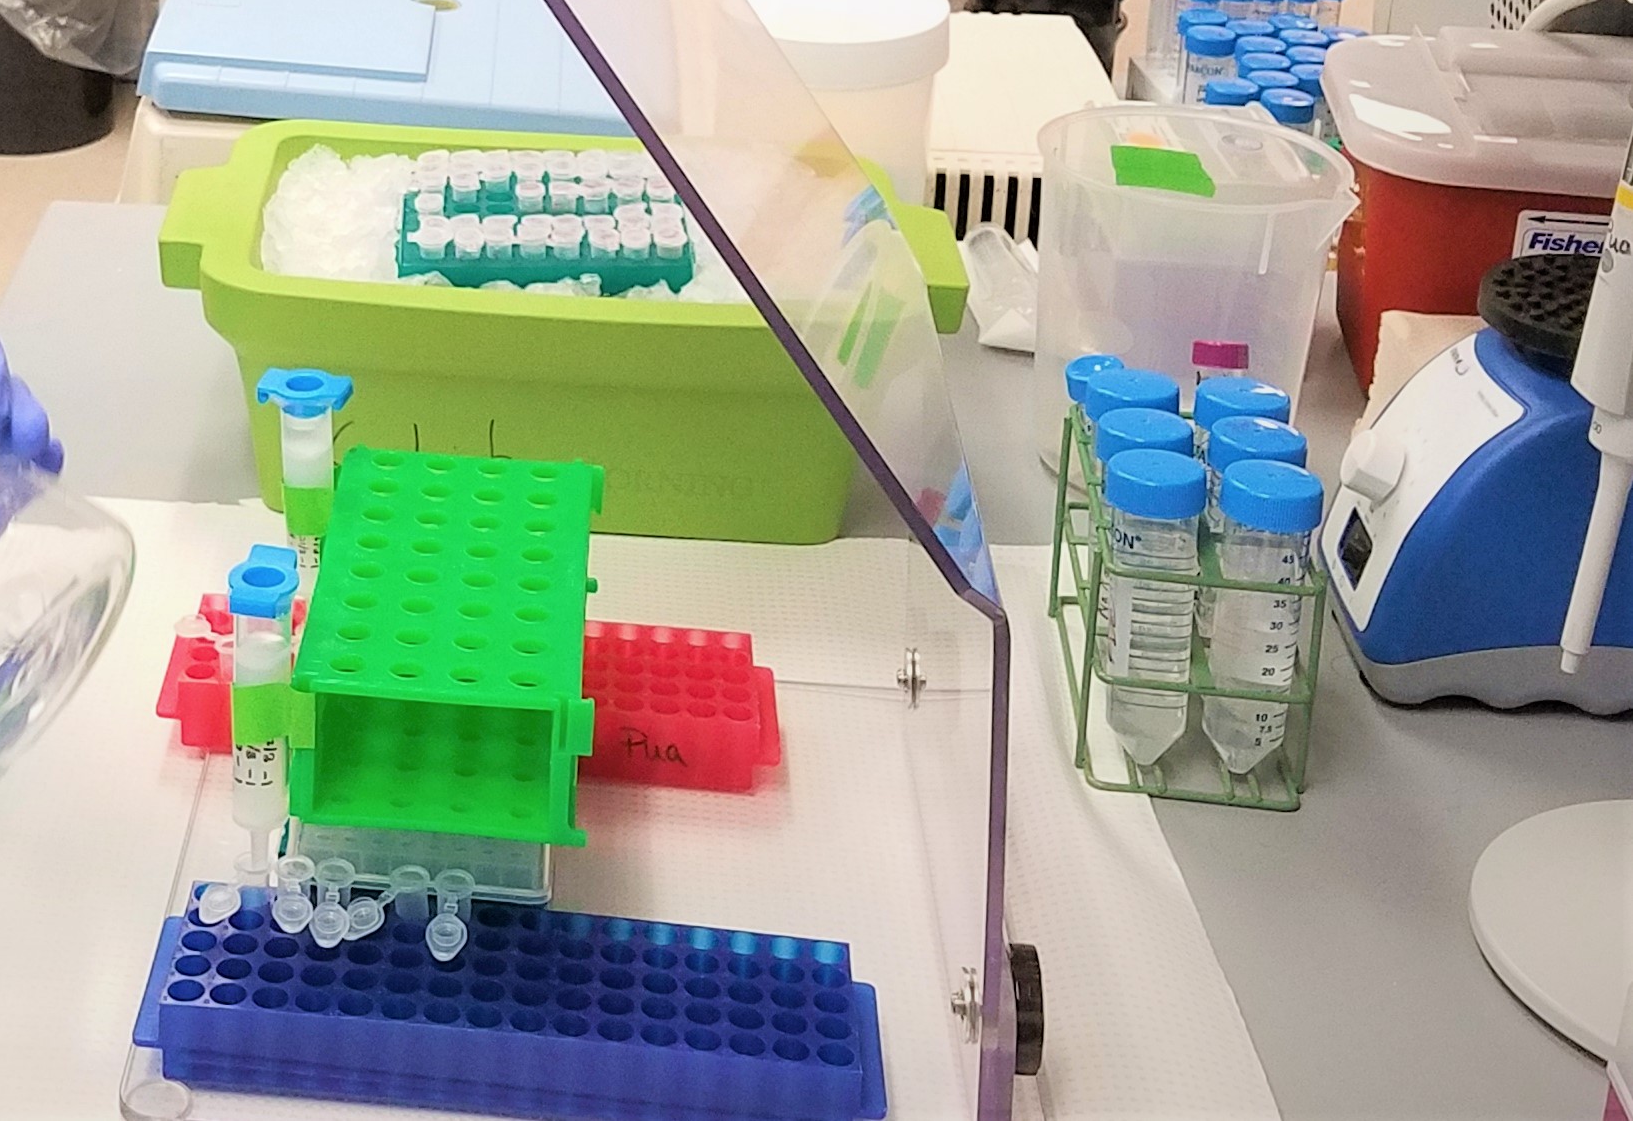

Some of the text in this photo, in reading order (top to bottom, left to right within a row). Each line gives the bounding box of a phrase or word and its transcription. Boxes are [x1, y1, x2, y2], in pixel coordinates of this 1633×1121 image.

[1281, 555, 1295, 565] 45
[1273, 599, 1287, 609] 35
[1269, 621, 1283, 630] 30
[1265, 644, 1279, 653] 25
[1261, 667, 1275, 676] 20
[1255, 713, 1268, 722] 10
[1254, 737, 1262, 746] 5
